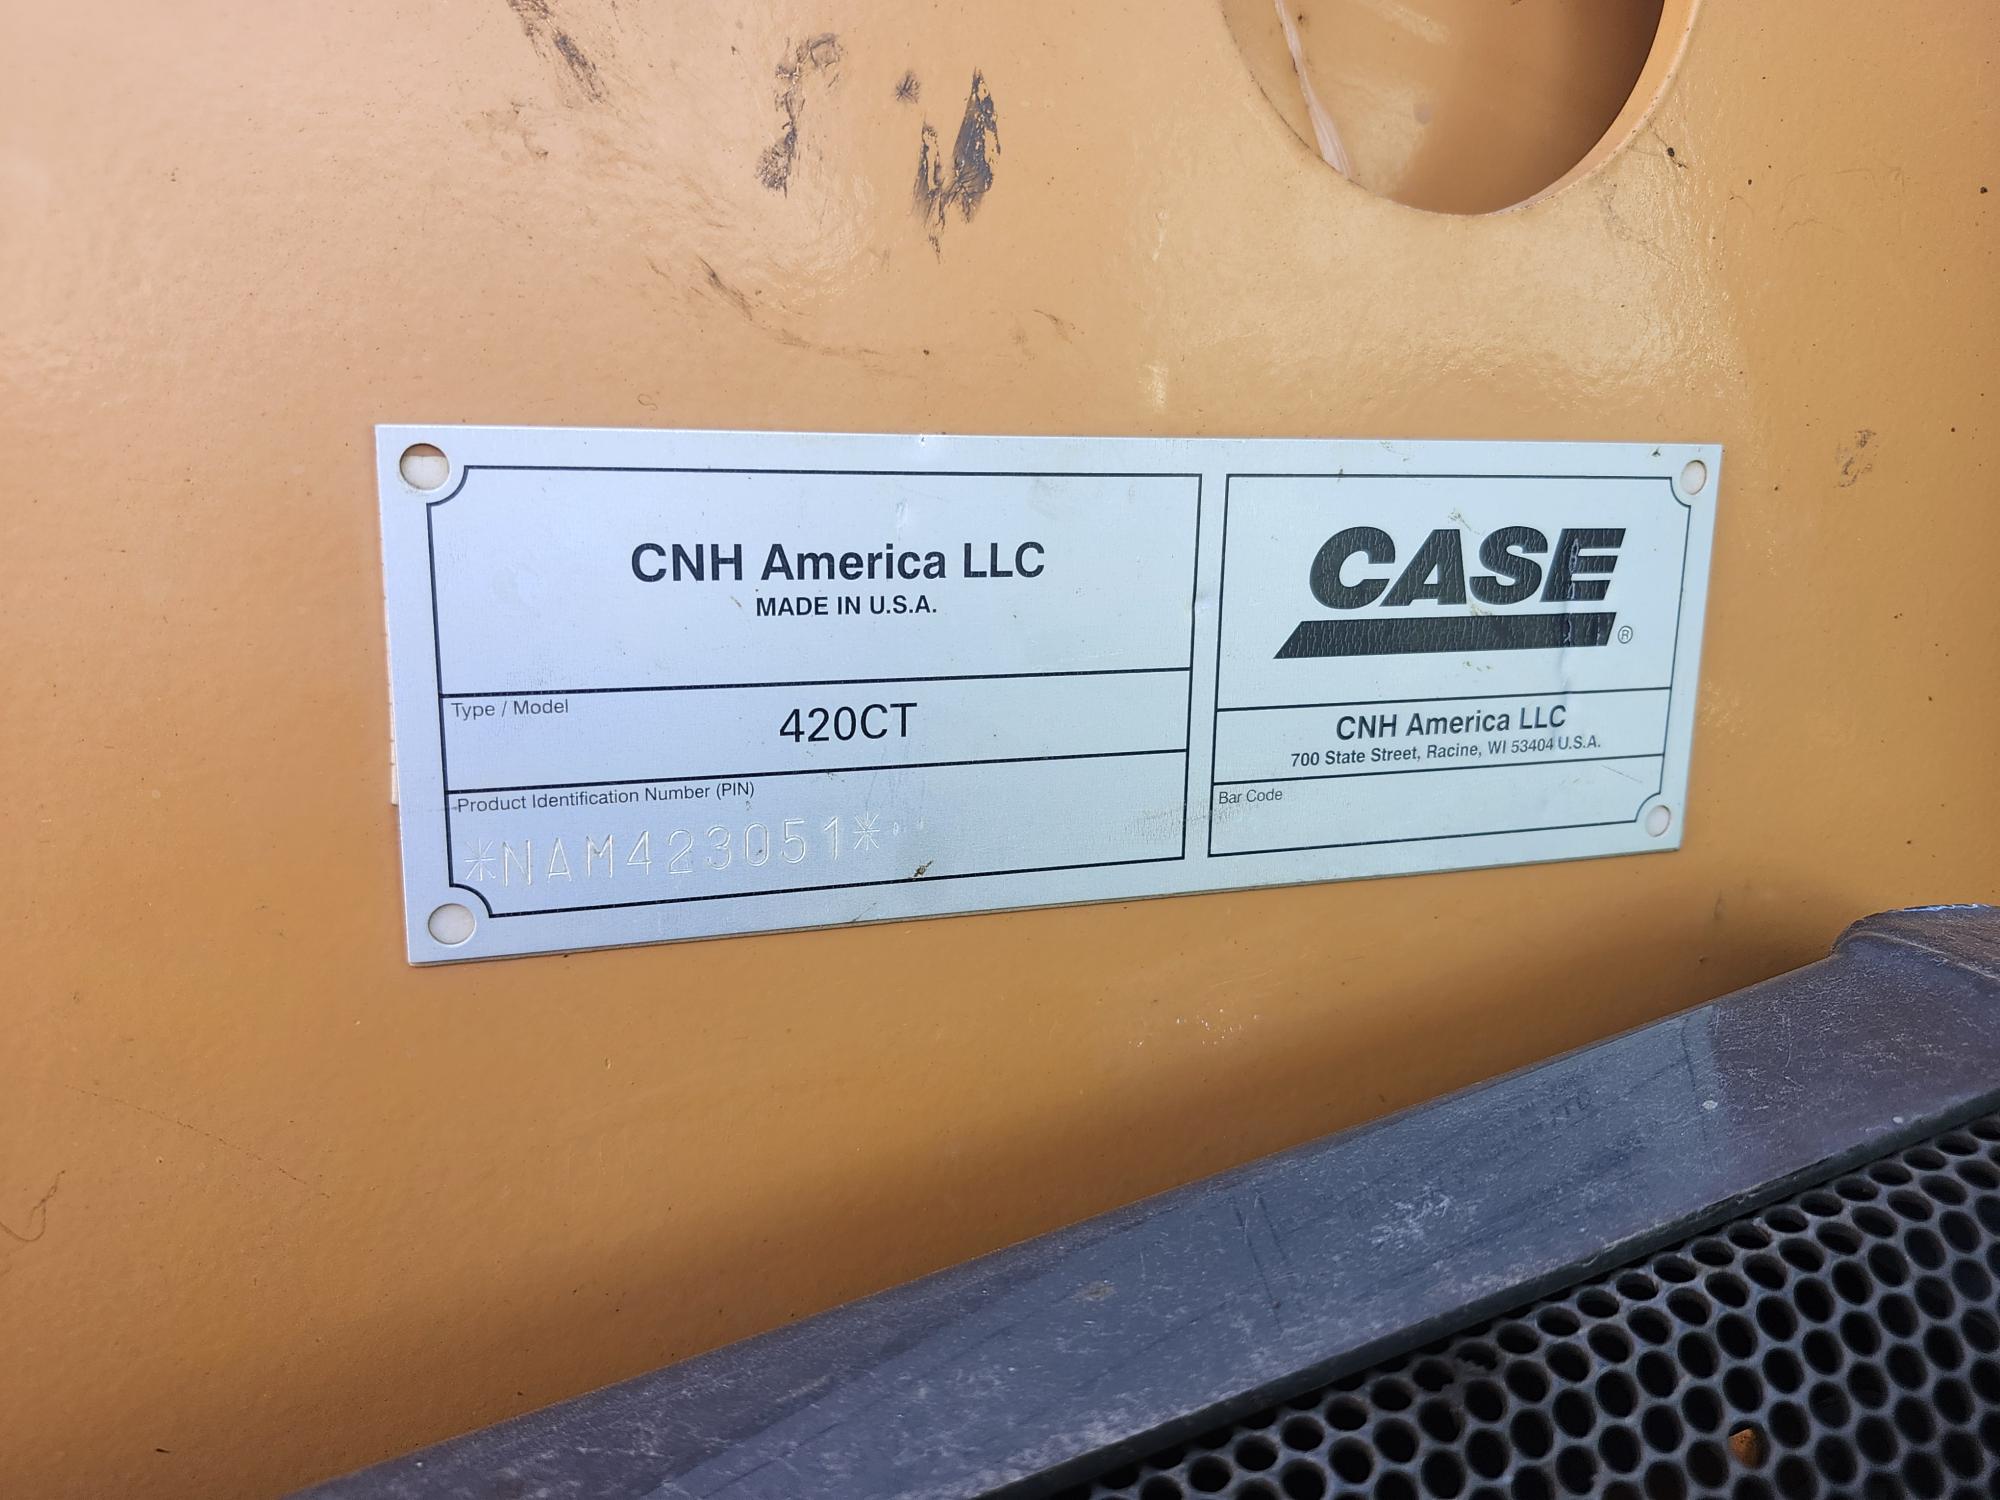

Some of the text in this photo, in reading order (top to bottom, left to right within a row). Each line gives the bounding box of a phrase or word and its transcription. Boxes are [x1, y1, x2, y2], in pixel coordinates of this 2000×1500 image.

[631, 541, 1046, 583] CNH America LLC
[1309, 525, 1627, 610] CASE
[756, 595, 938, 616] MADE IN U.S.A.
[451, 701, 496, 721] Type
[514, 698, 569, 717] Model
[779, 702, 918, 743] 420CT
[1336, 704, 1567, 741] CNH America LLC
[1291, 733, 1602, 769] 700 State Street, Racine, WI 53404 U.S.A.
[457, 780, 755, 814] Product Identification Number (PIN)
[1218, 786, 1283, 805] Bar Code
